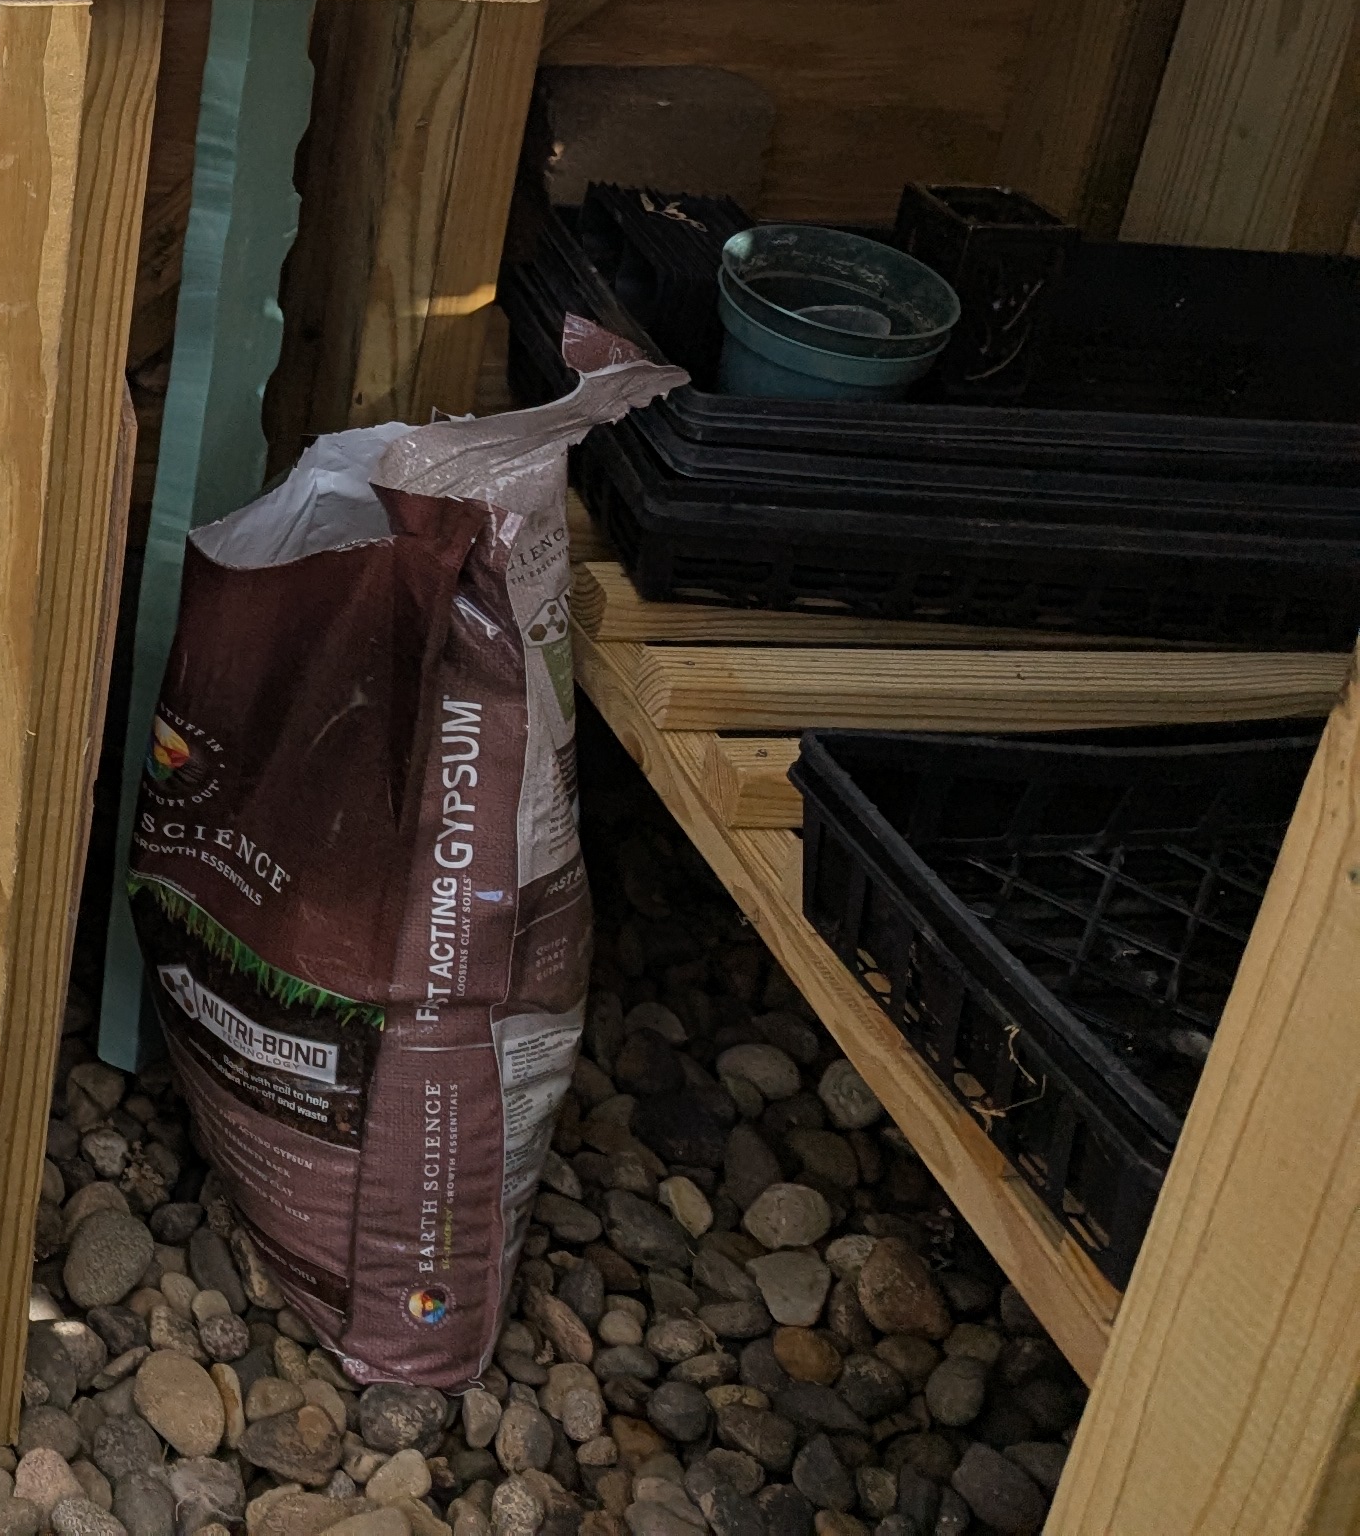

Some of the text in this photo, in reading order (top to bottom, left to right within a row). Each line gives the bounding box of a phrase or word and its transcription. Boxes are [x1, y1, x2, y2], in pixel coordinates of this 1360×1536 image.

[206, 737, 225, 753] IN
[191, 778, 220, 805] OUT
[433, 699, 483, 870] GYPSUM
[141, 812, 288, 894] SCIENCE
[200, 850, 264, 907] ESSENTIALS
[429, 876, 460, 981] ACTING
[456, 875, 473, 998] LOOSENS CLAY SOILS
[201, 992, 329, 1070] NUTRI-BOND
[221, 1029, 301, 1071] TECHNOLOGY
[250, 1074, 271, 1089] with
[292, 1089, 304, 1101] to
[305, 1092, 330, 1110] help
[277, 1096, 296, 1112] and
[296, 1104, 329, 1124] waste
[449, 1083, 459, 1154] ESSENTIALS
[418, 1081, 442, 1274] EARTH SCIENCE
